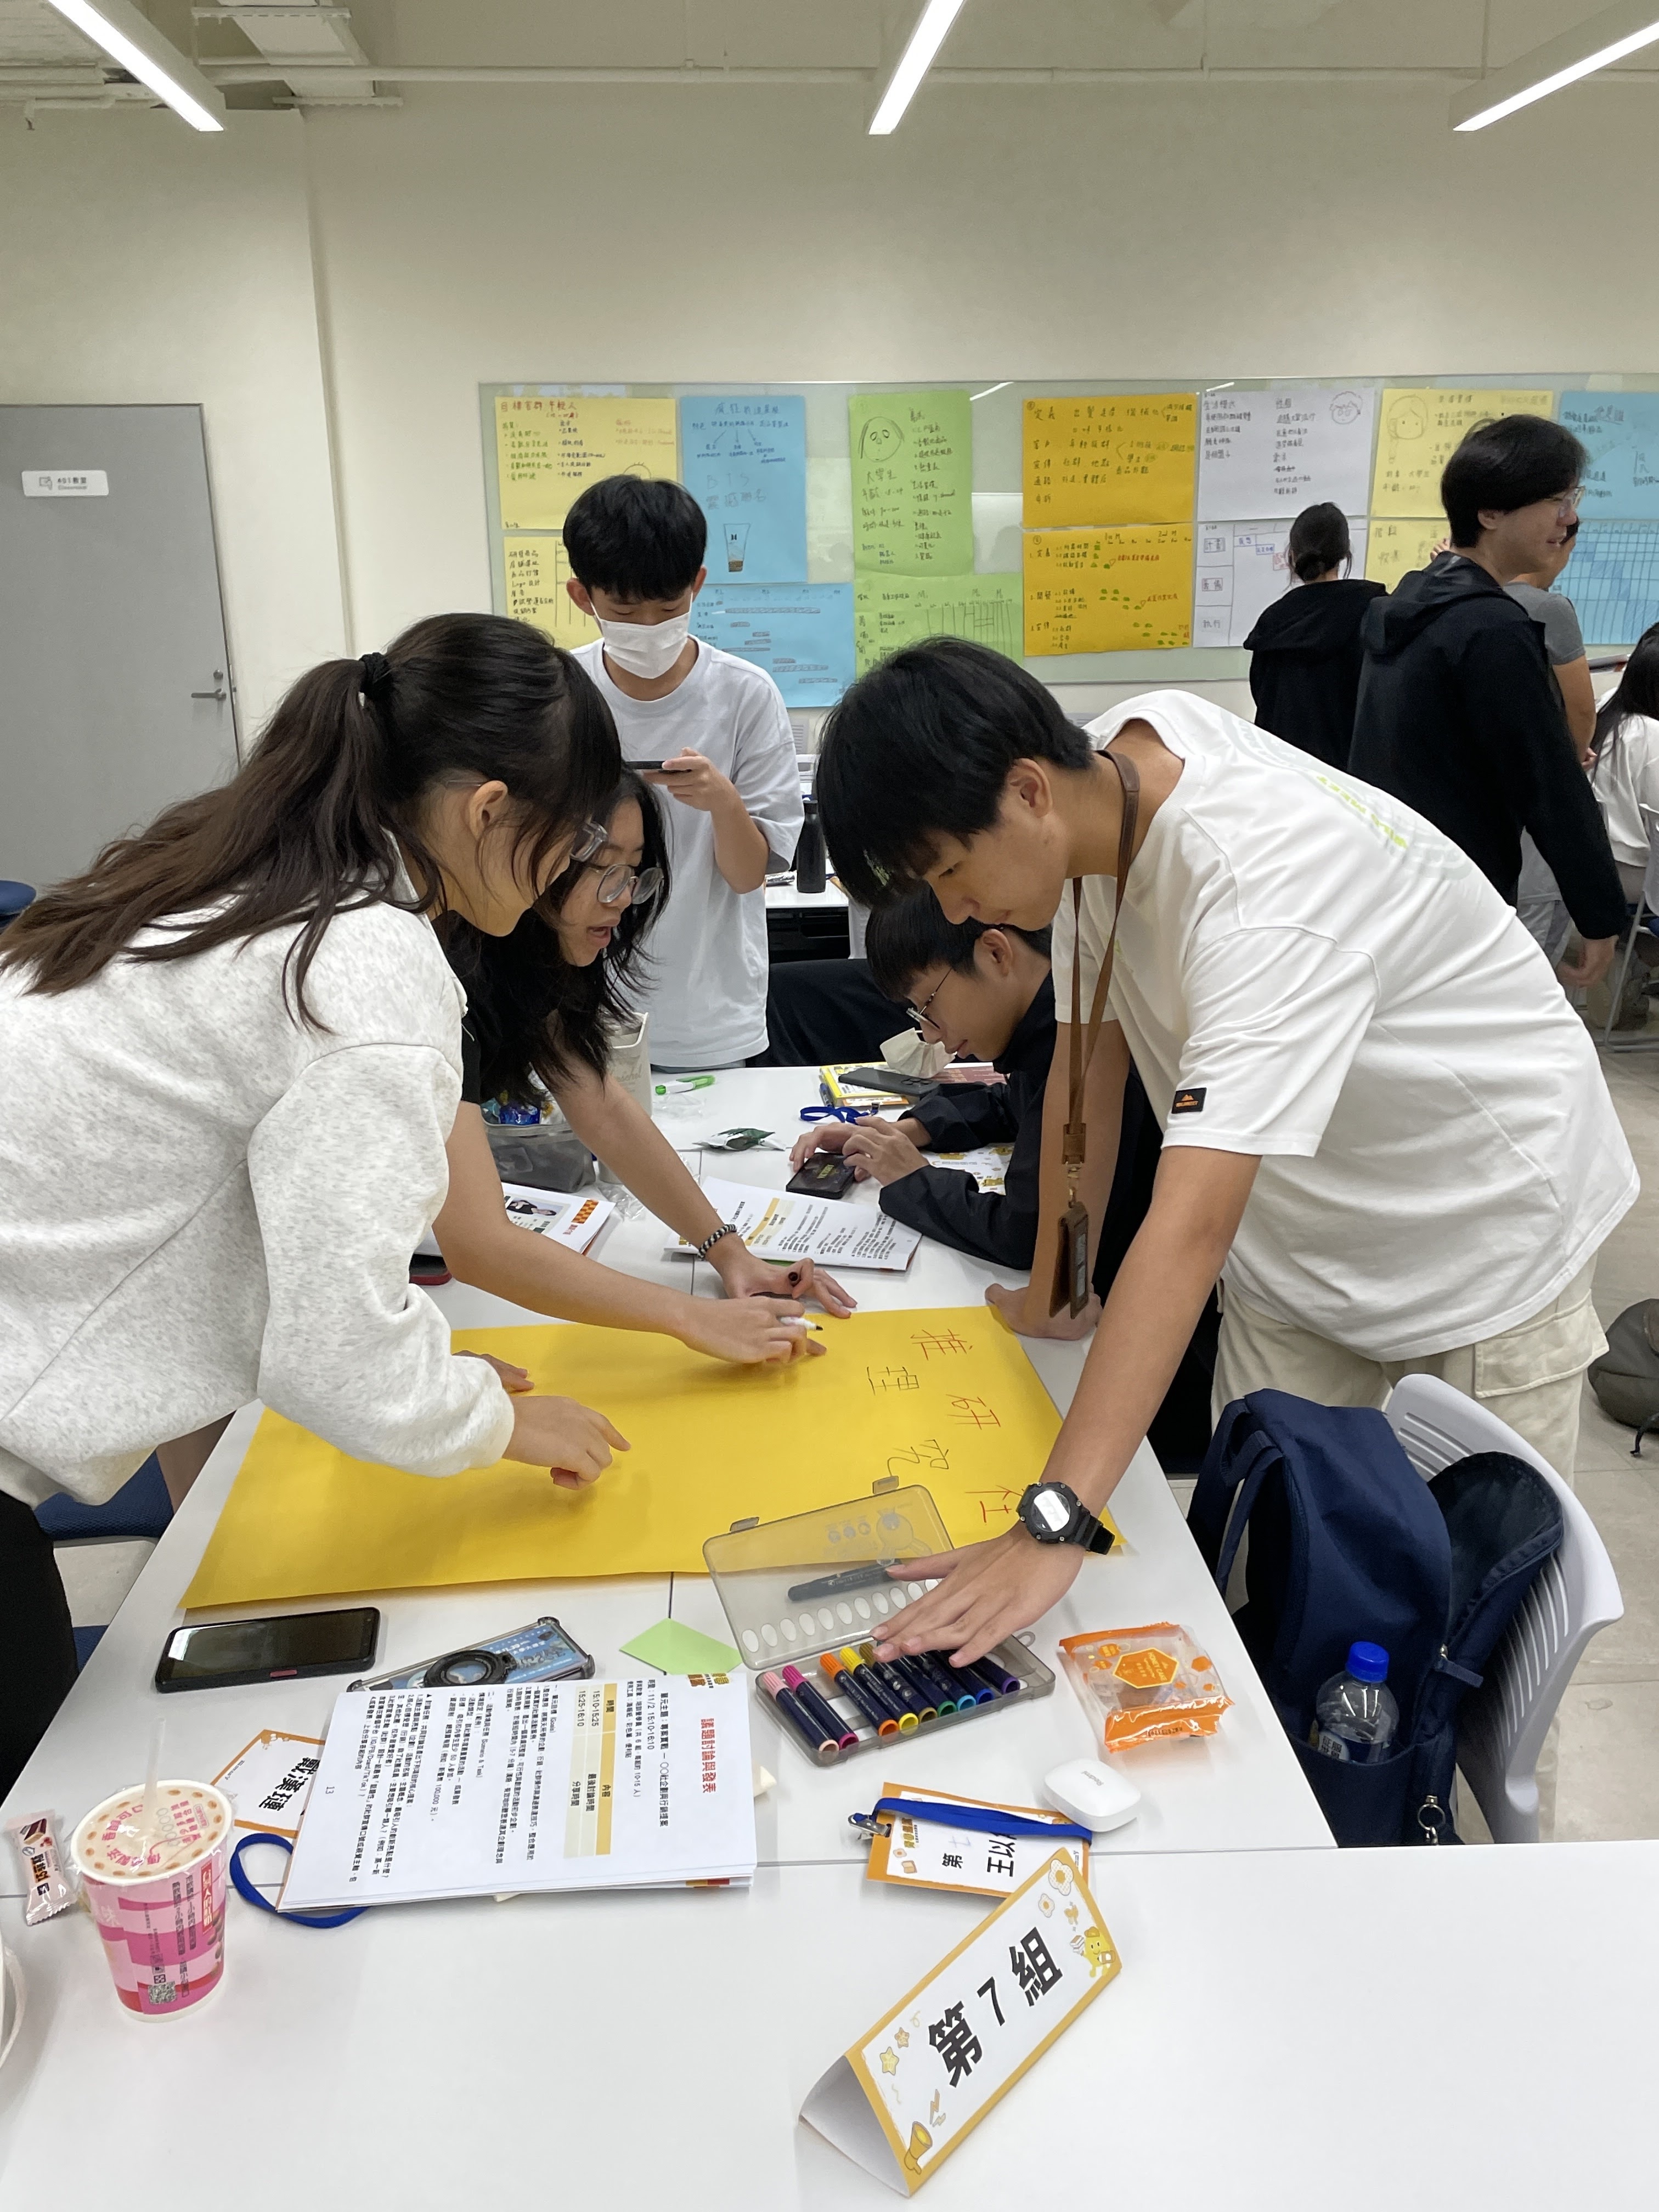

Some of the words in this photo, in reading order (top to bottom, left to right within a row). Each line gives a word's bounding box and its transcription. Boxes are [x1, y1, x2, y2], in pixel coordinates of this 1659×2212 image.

[577, 1690, 586, 1726] 15:25-16:10
[591, 1690, 600, 1726] 15:10-15:25
[606, 1700, 614, 1713] 時間
[701, 1718, 717, 1793] 議題討論與發表
[325, 1786, 335, 1795] 13
[571, 1781, 580, 1807] 分享時間
[602, 1785, 611, 1797] 內容
[987, 1831, 1018, 1878] 王以
[928, 2001, 983, 2088] 第
[977, 1976, 1007, 2027] 7
[1008, 1926, 1063, 2007] 組
